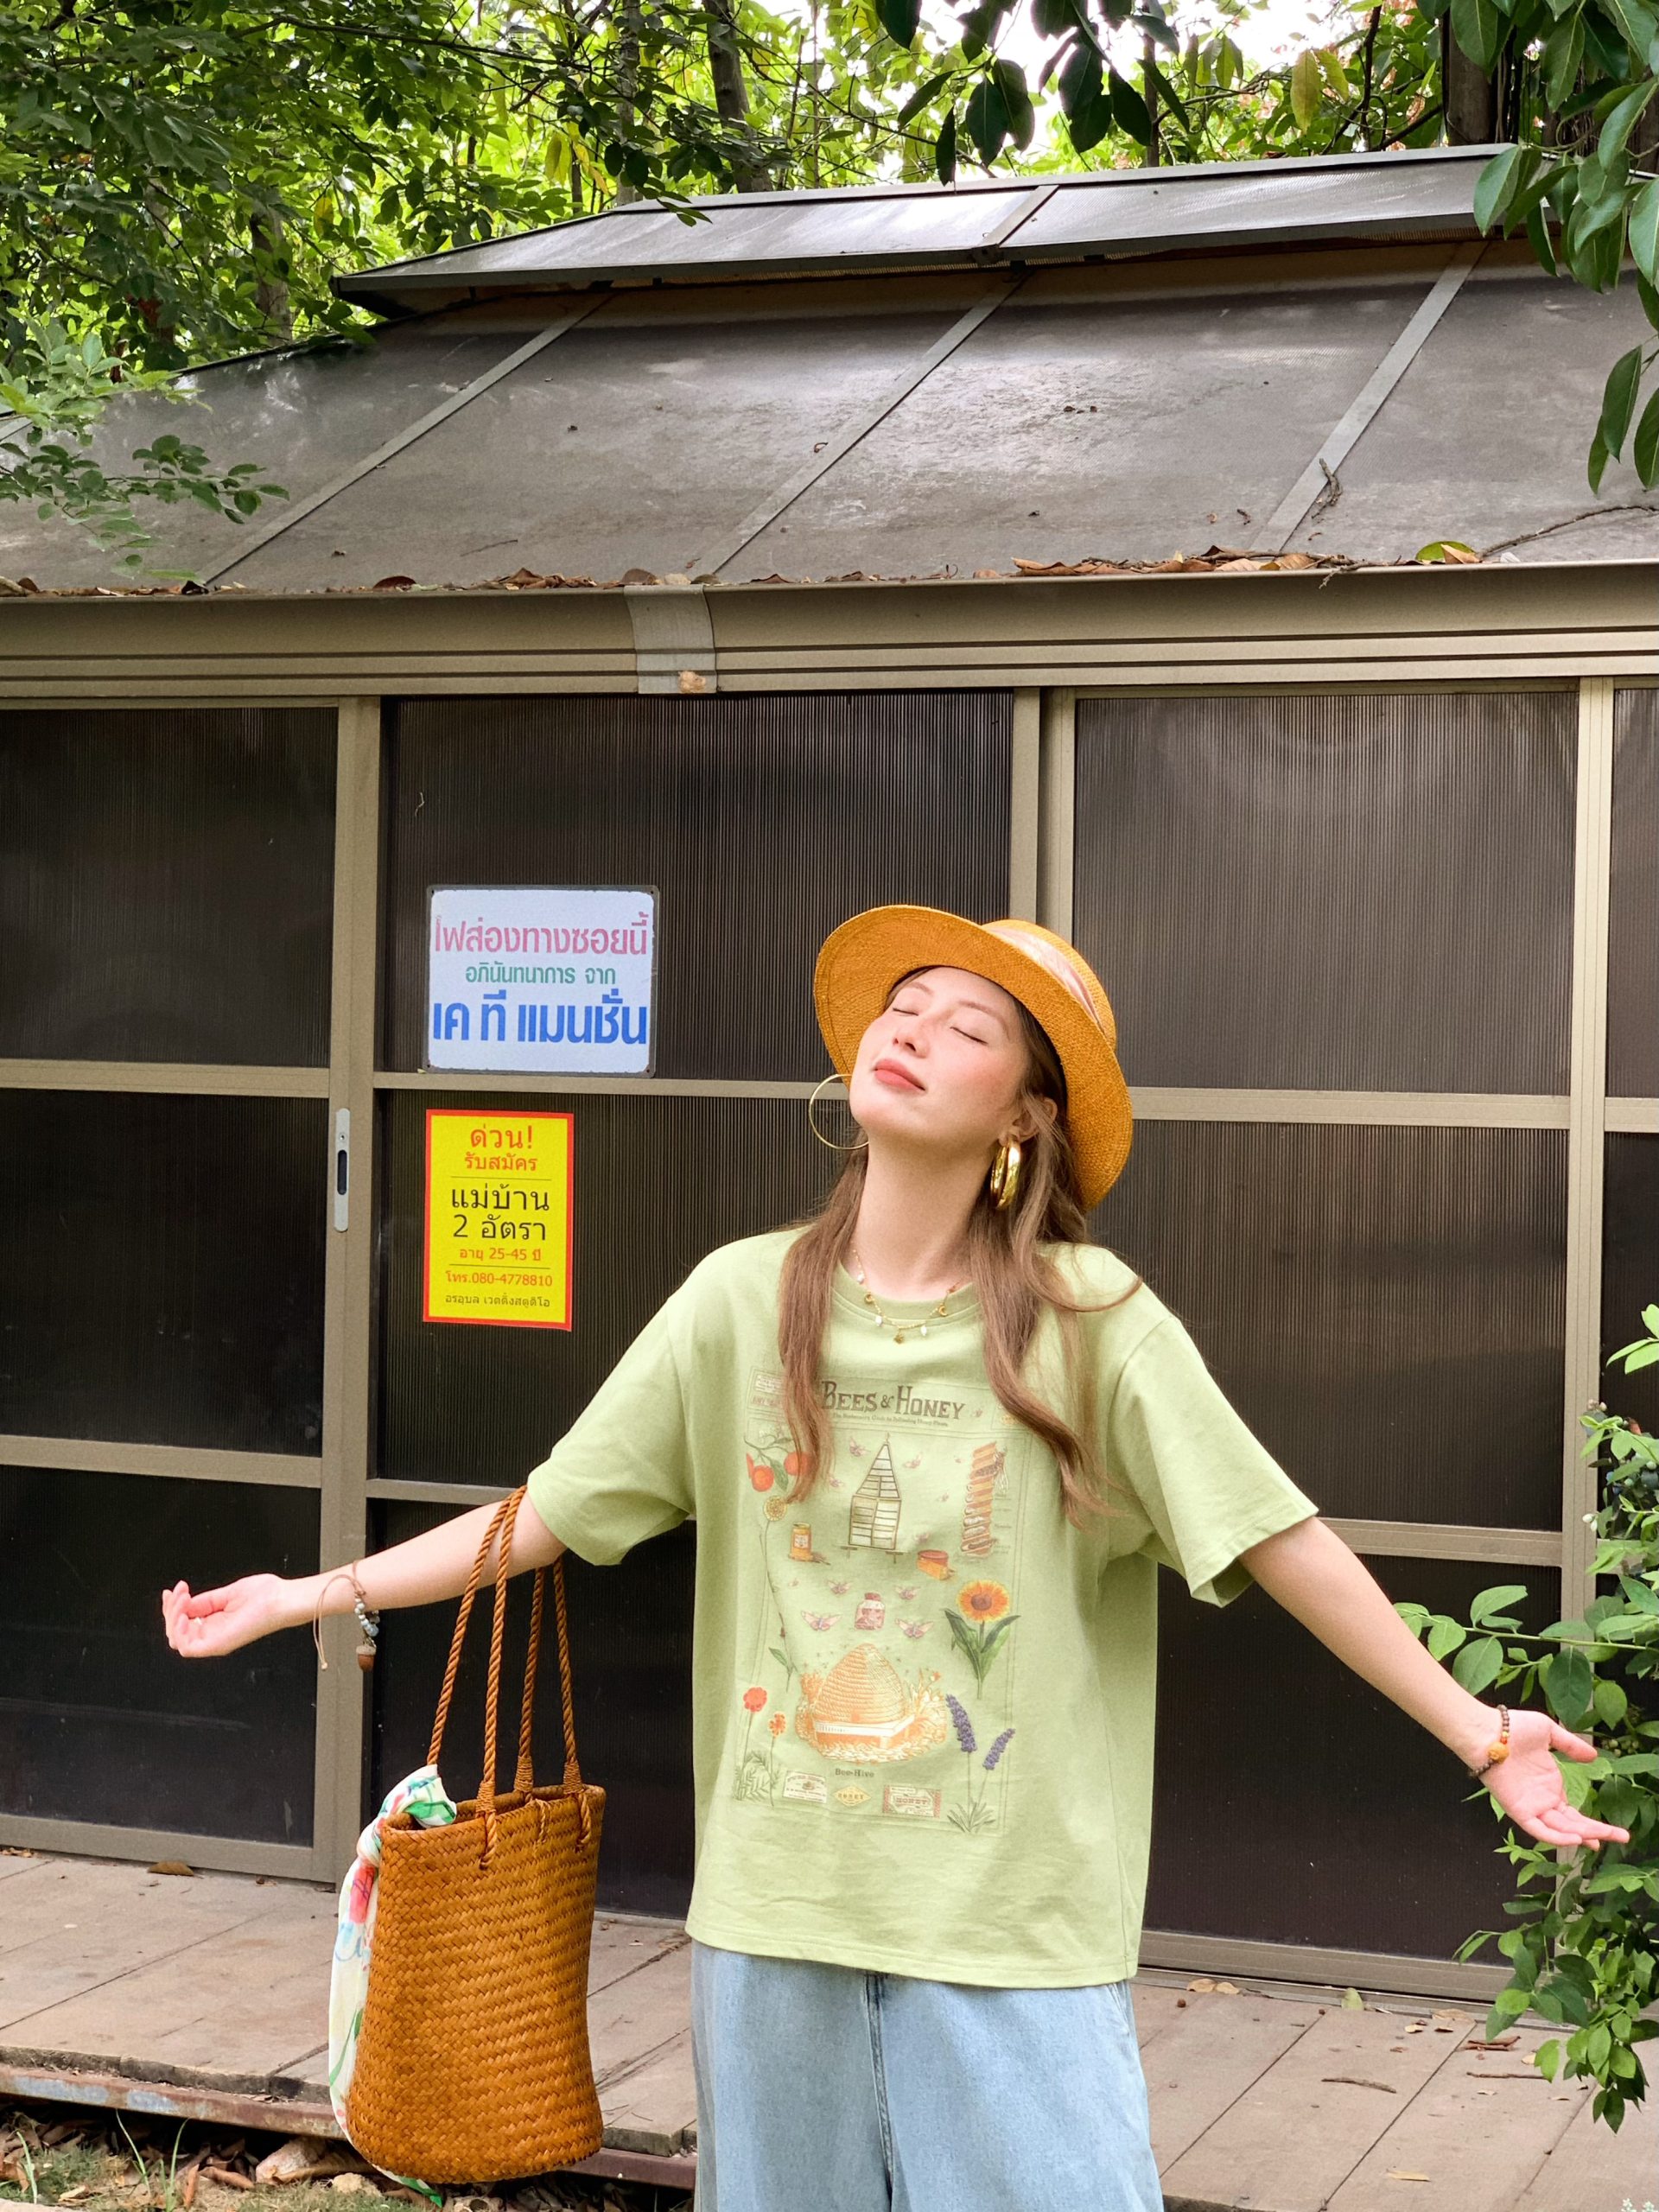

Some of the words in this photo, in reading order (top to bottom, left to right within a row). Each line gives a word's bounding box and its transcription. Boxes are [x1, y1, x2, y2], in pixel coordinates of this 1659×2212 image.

[435, 912, 649, 955] ไฟส่องทางซอยนี้
[465, 961, 575, 984] อภินันทนาการ
[585, 967, 616, 985] จาก
[433, 1002, 470, 1041] เค
[480, 989, 507, 1042] ที
[518, 988, 647, 1045] แมนชั่น
[470, 1124, 533, 1149] ด่วน!
[464, 1151, 538, 1172] รับสมัคร
[452, 1183, 550, 1211] แม่บ้าน
[453, 1214, 468, 1238] 2
[481, 1213, 546, 1241] อัตรา
[460, 1249, 484, 1262] อายุ
[489, 1248, 527, 1262] 25-45
[880, 1395, 894, 1409] &
[894, 1385, 966, 1420] HONEY
